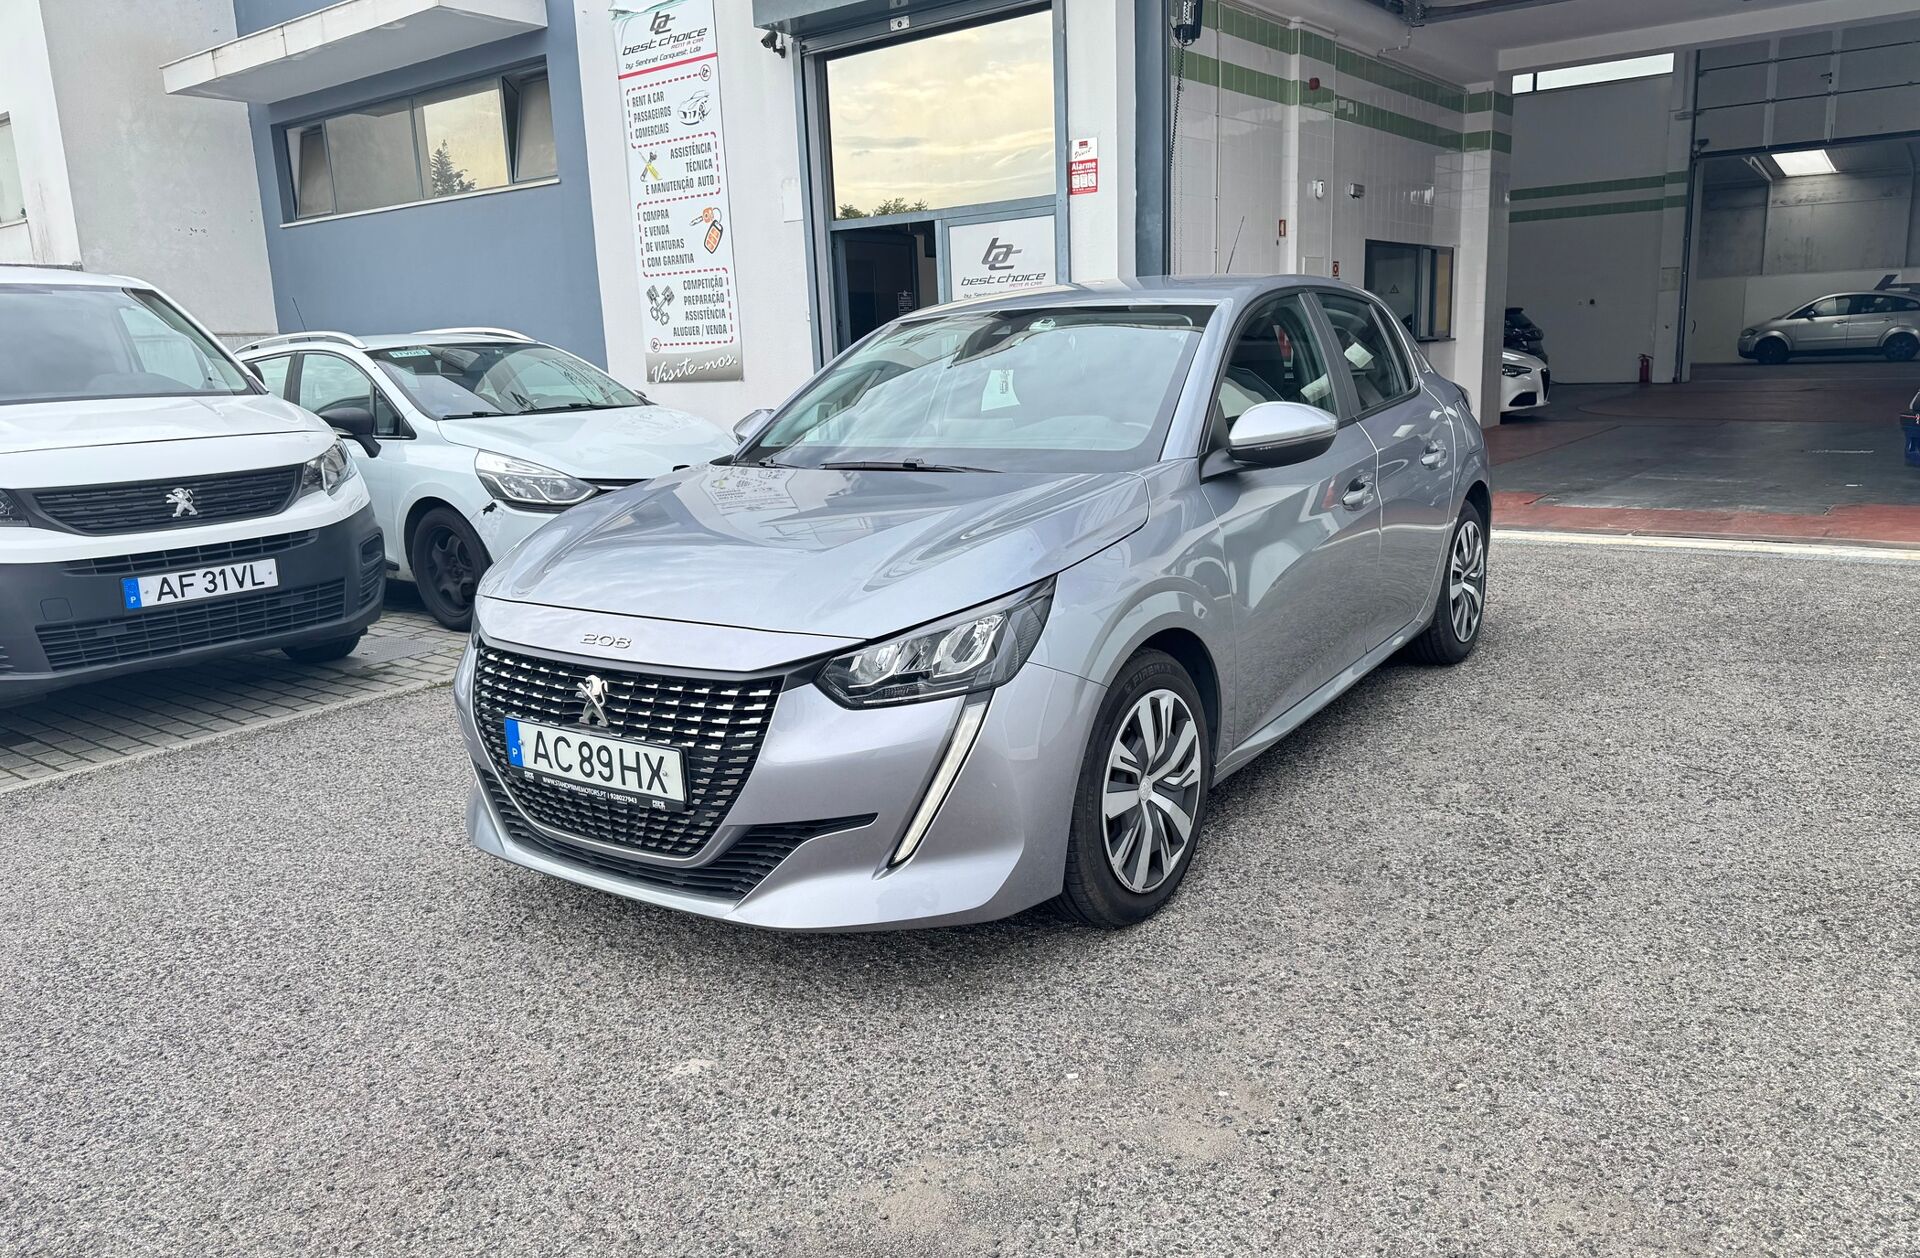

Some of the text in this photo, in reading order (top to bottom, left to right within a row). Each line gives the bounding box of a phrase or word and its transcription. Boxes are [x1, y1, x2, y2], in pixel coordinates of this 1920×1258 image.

[622, 28, 707, 56] best choice
[635, 56, 658, 66] Sentinel
[632, 91, 664, 108] RENT A CAR
[634, 106, 672, 123] PASSAGEIROS
[635, 122, 670, 138] COMERCIAIS
[670, 142, 712, 159] ASSISTÊNCIA
[686, 158, 713, 172] TÉCNICA
[646, 174, 714, 195] E MANUTENÇÃO AUTO
[643, 208, 670, 222] COMPRA
[644, 224, 670, 237] E VENDA
[646, 238, 685, 252] DE VIATURAS
[647, 253, 694, 267] COM GARANTIA
[683, 275, 723, 291] COMPETIÇÃO
[961, 272, 1046, 286] best choice
[684, 291, 725, 307] PREPARAÇÃO
[685, 307, 726, 321] ASSISTÊNCIA
[673, 326, 700, 337] ALUGUER
[706, 324, 727, 335] VENDA
[651, 354, 737, 383] Visite-nos.
[130, 596, 136, 604] P
[580, 633, 632, 649] 208
[513, 748, 518, 758] P
